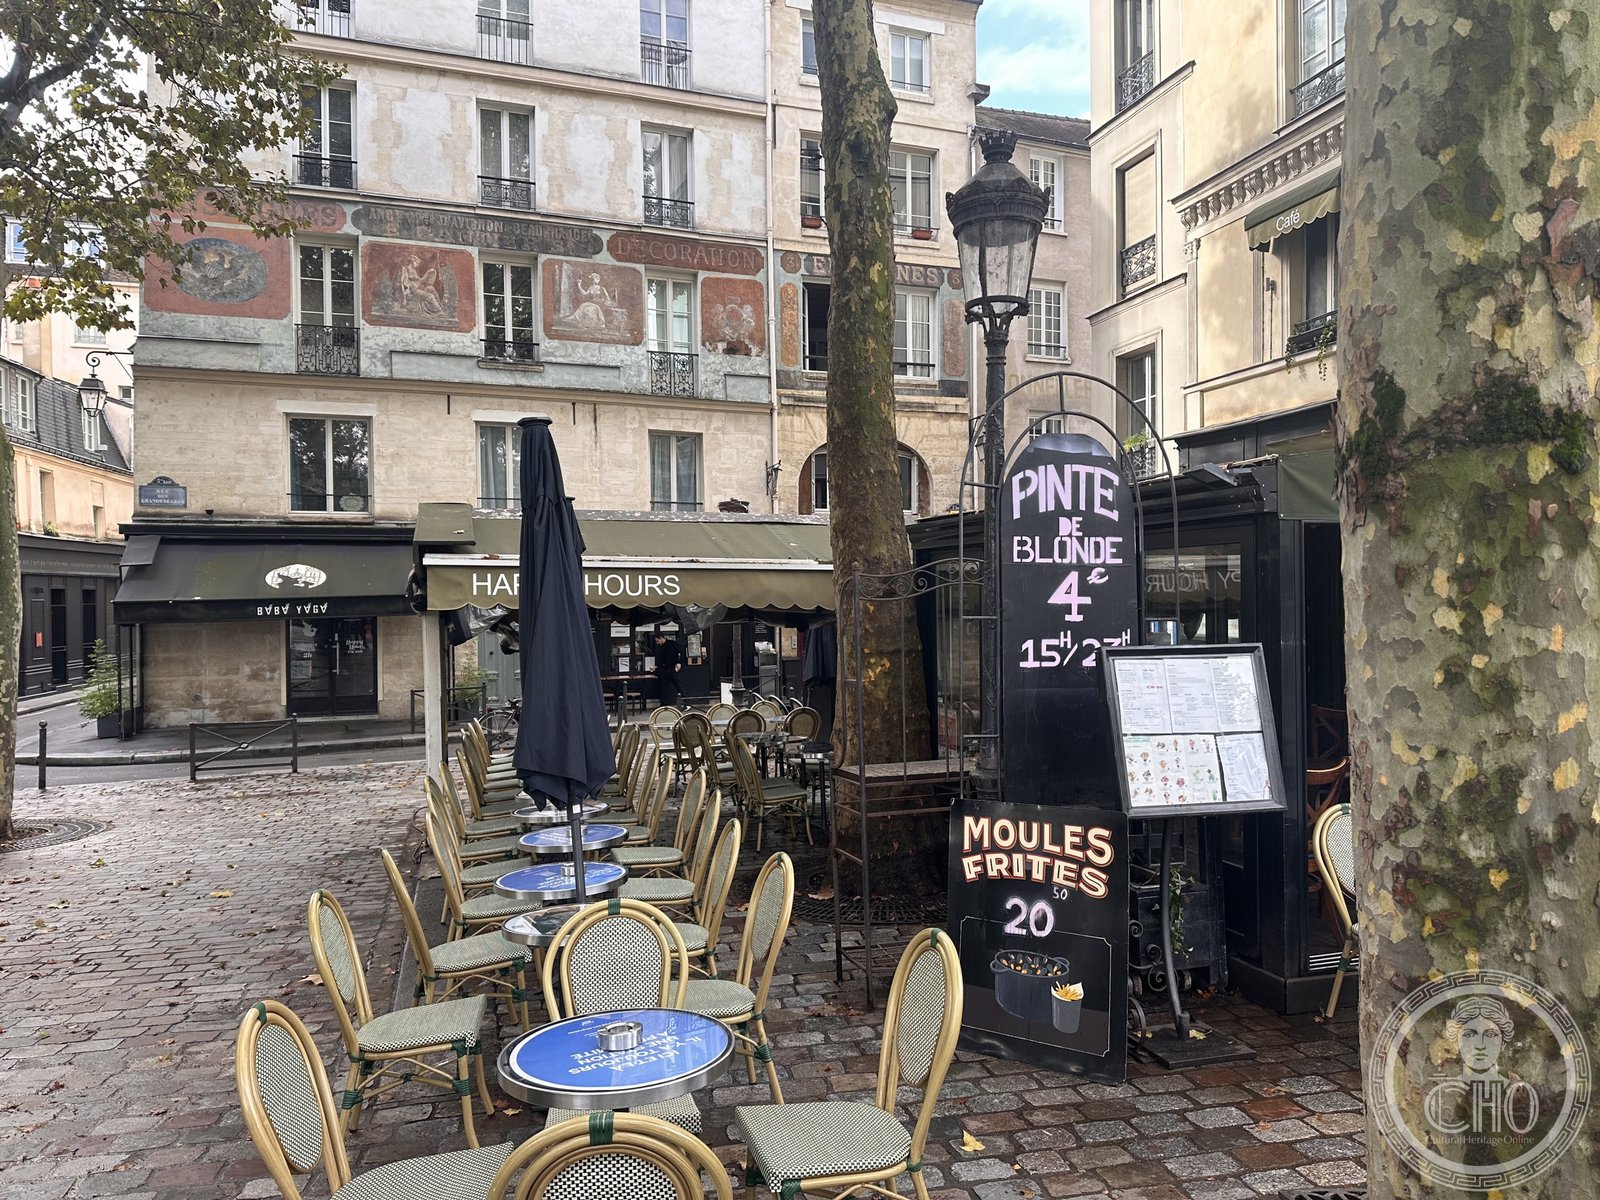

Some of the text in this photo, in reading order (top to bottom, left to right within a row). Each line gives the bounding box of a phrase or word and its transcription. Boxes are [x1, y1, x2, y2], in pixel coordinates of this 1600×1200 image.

[1276, 209, 1300, 231] Café
[1011, 464, 1119, 522] PINTE
[1059, 516, 1083, 536] DE
[1013, 536, 1123, 564] BLONDE
[584, 574, 681, 597] HOURS
[257, 602, 328, 616] BABA YAGA
[962, 815, 1115, 868] MOULES
[961, 852, 1111, 899] FRITES
[1003, 896, 1056, 938] 20
